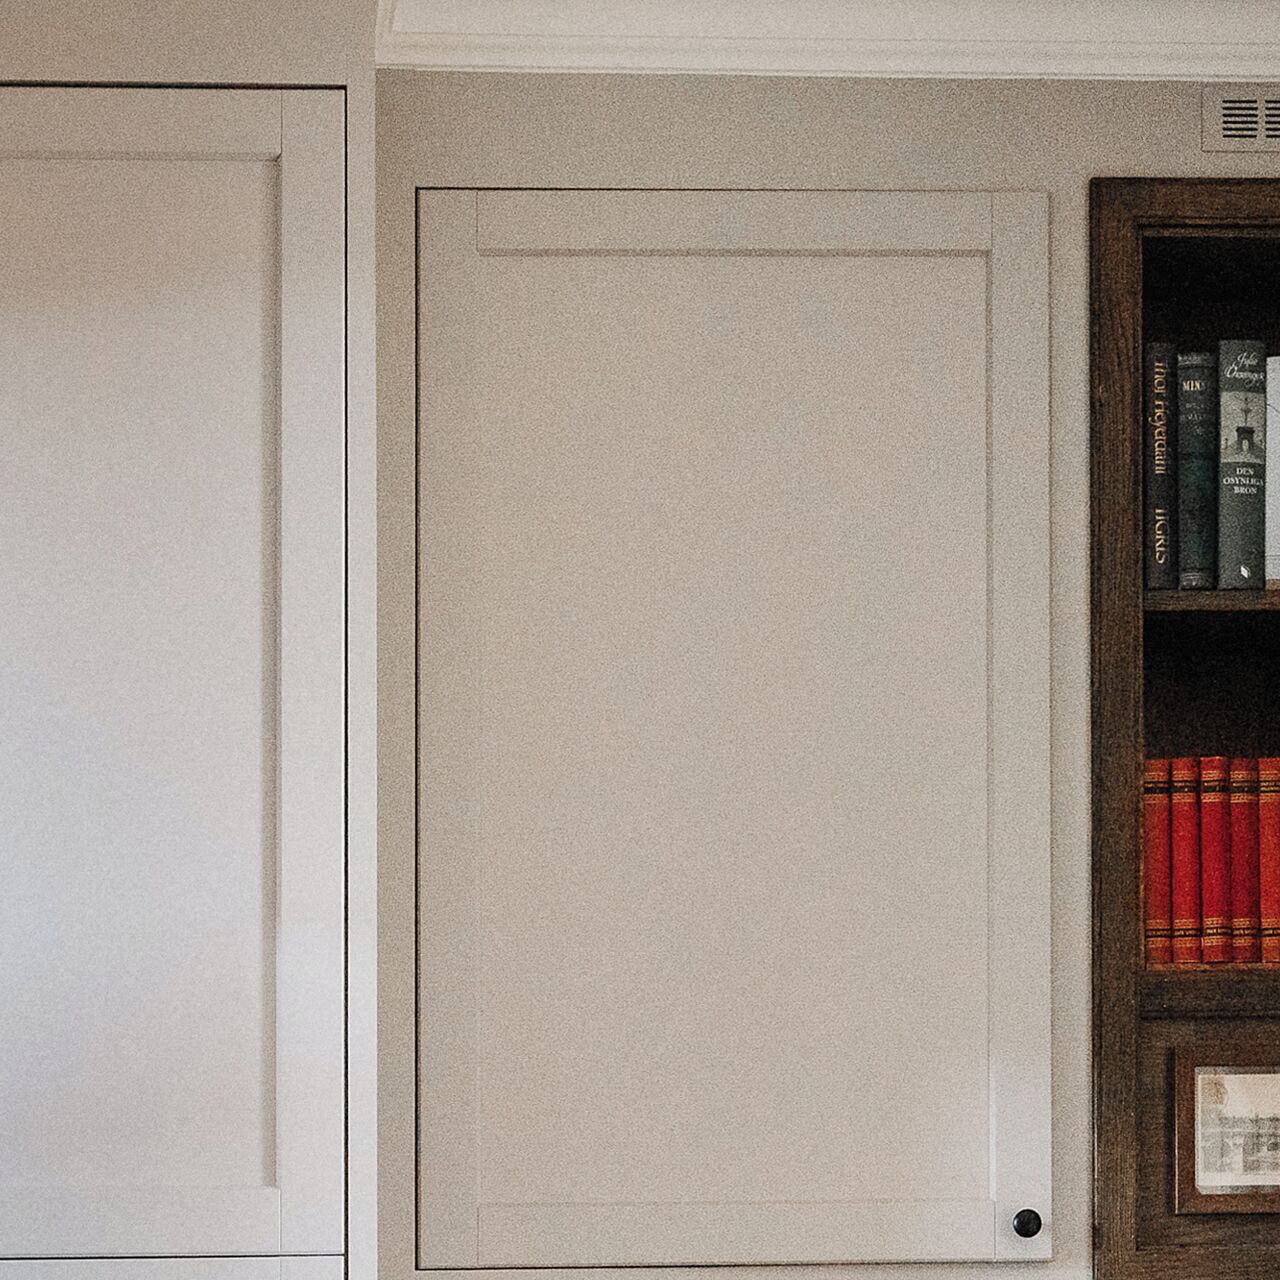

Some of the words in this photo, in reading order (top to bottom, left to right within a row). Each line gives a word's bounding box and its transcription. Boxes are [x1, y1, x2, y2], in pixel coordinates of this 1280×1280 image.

[1154, 362, 1169, 396] Thor
[1236, 467, 1254, 475] DEN
[1233, 486, 1257, 494] BRON
[1154, 508, 1170, 565] TIGRIS
